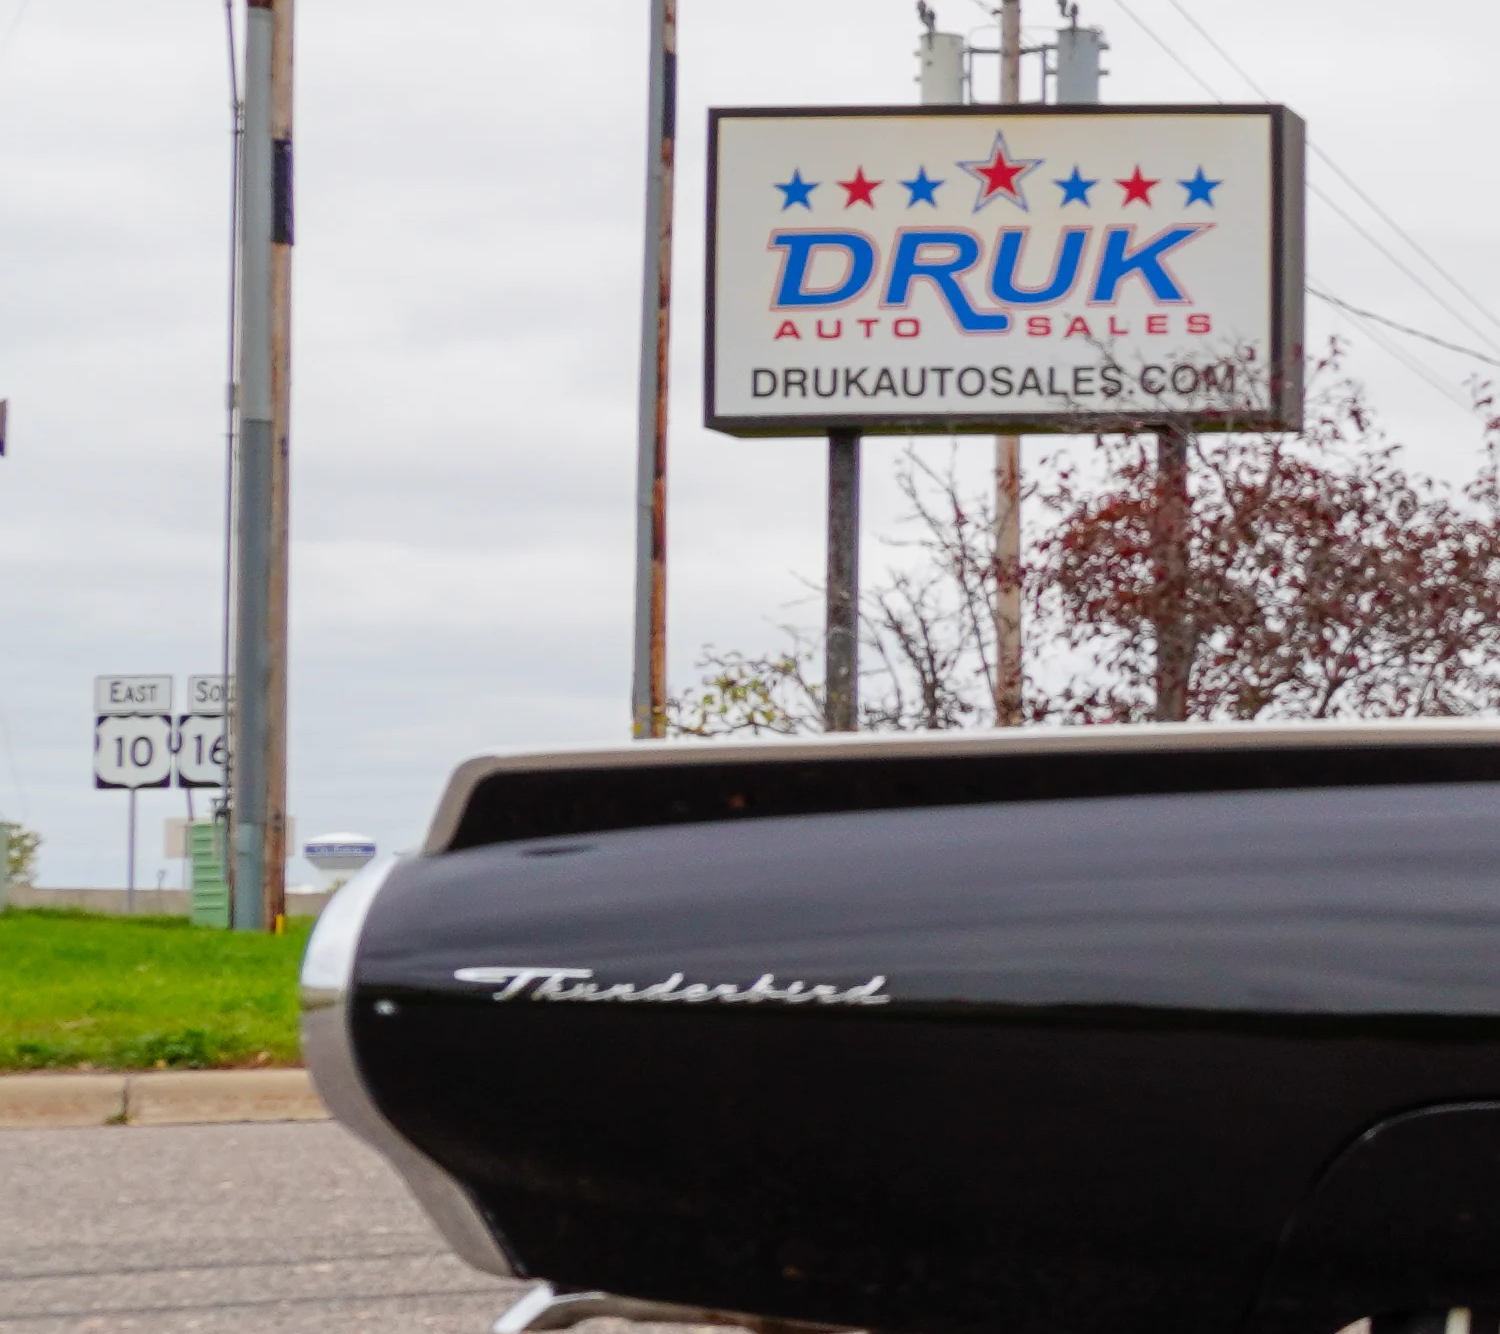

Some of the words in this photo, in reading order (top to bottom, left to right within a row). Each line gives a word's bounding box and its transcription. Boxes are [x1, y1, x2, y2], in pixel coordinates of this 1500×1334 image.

[767, 223, 1217, 336] DRUK
[774, 318, 921, 340] AUTO
[1026, 313, 1212, 338] SALES
[751, 365, 1236, 399] DRUKAUTOSALES.COM
[109, 681, 160, 704] EAST
[115, 735, 154, 768] 10
[193, 734, 229, 766] 16
[453, 967, 892, 1005] Thunderbird
